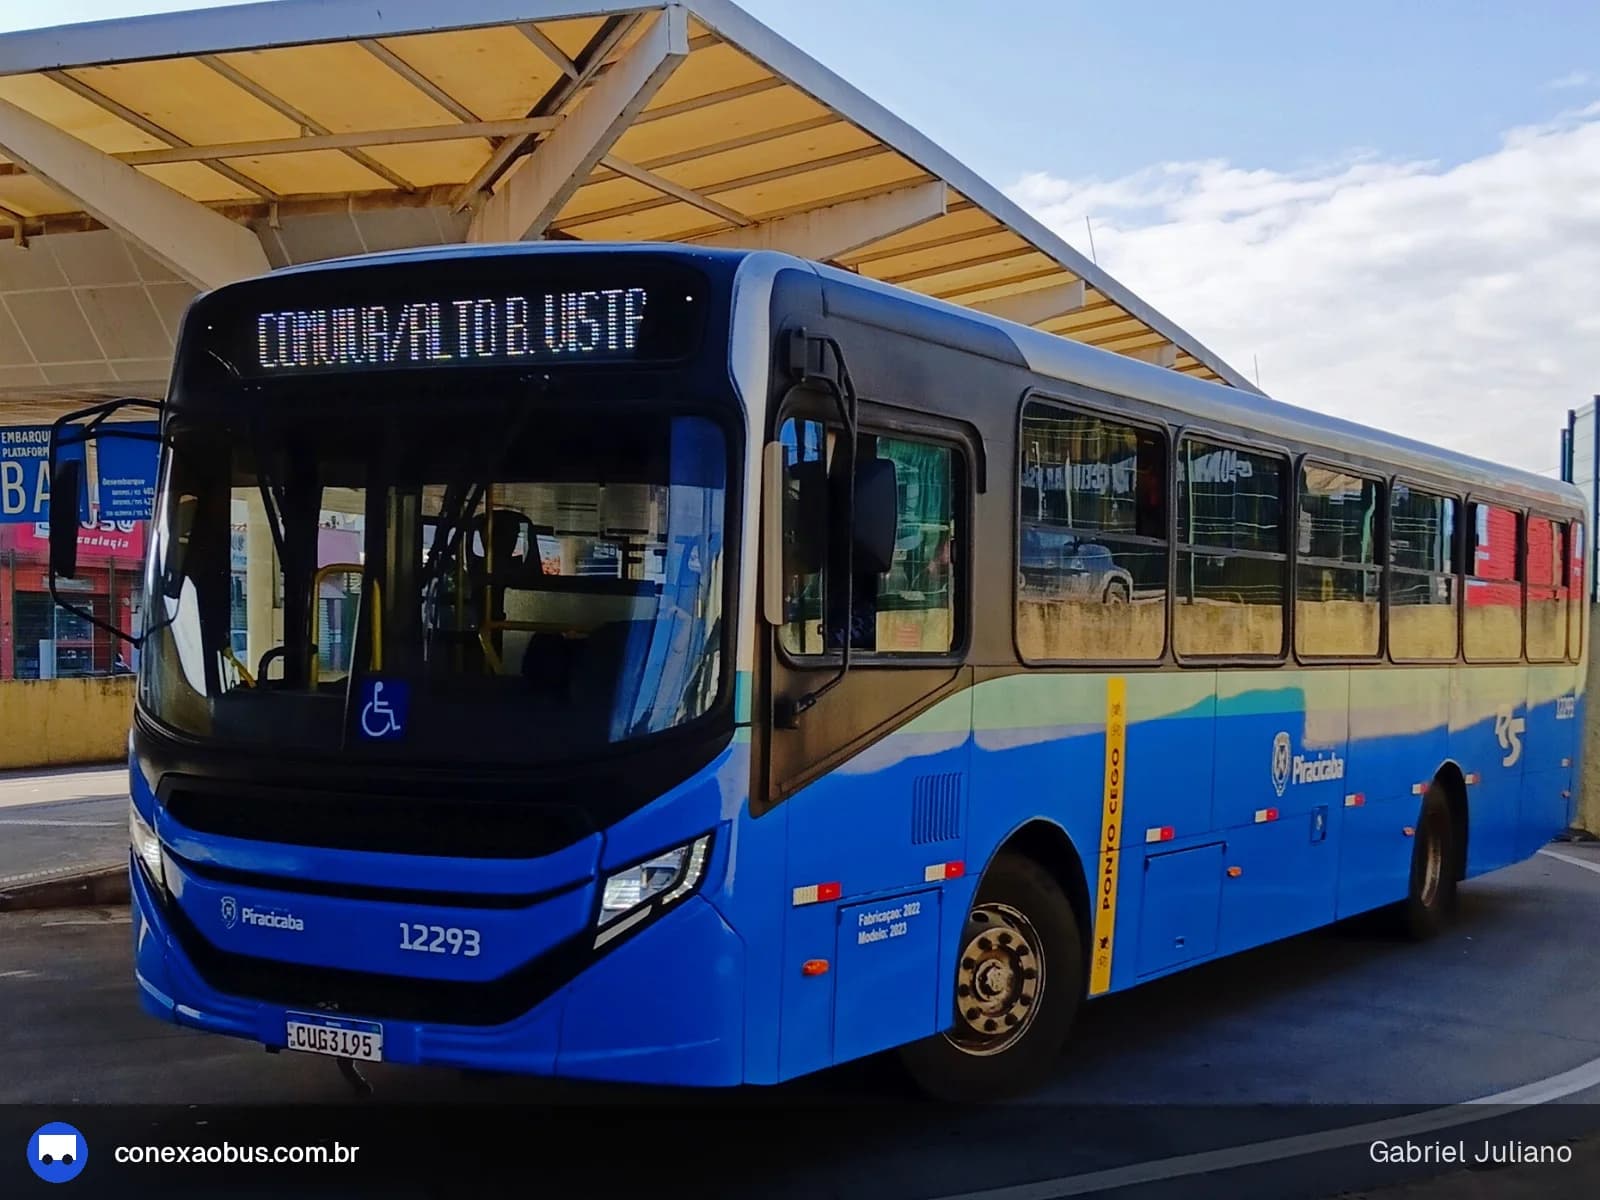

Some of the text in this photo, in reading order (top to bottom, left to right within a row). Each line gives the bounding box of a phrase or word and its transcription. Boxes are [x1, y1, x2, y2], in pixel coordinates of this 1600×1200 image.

[506, 297, 535, 355] B.
[1, 431, 50, 443] EMBARQU
[2, 447, 50, 457] PLATAFORM
[1292, 752, 1344, 784] Piracicaba
[1103, 748, 1120, 910] PONTO CEGO
[242, 908, 304, 931] Piracicaba
[400, 923, 480, 956] 12293
